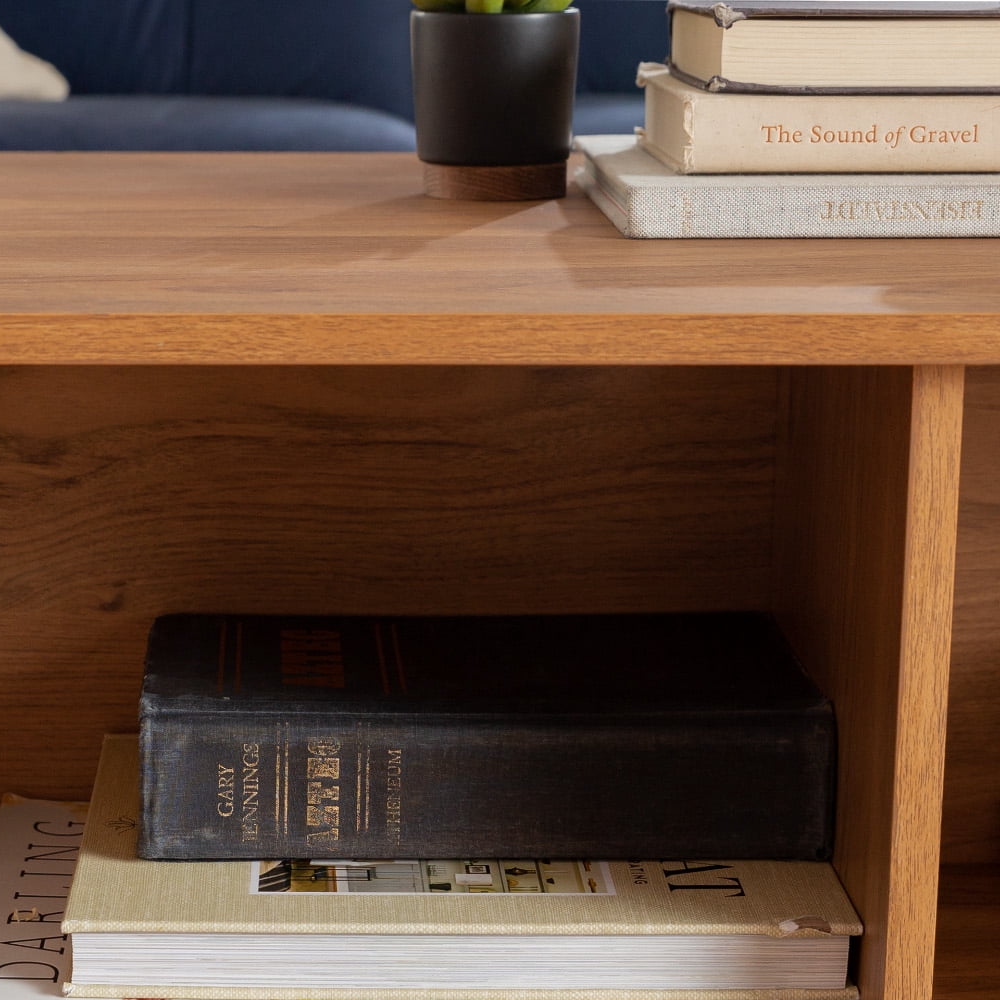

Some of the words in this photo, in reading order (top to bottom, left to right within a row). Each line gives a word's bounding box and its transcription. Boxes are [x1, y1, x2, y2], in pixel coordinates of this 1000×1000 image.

[761, 124, 803, 143] The
[810, 125, 878, 143] Sound
[884, 126, 906, 148] of
[909, 124, 979, 143] Gravel
[217, 763, 235, 817] GARY
[242, 743, 260, 842] JENNINGS
